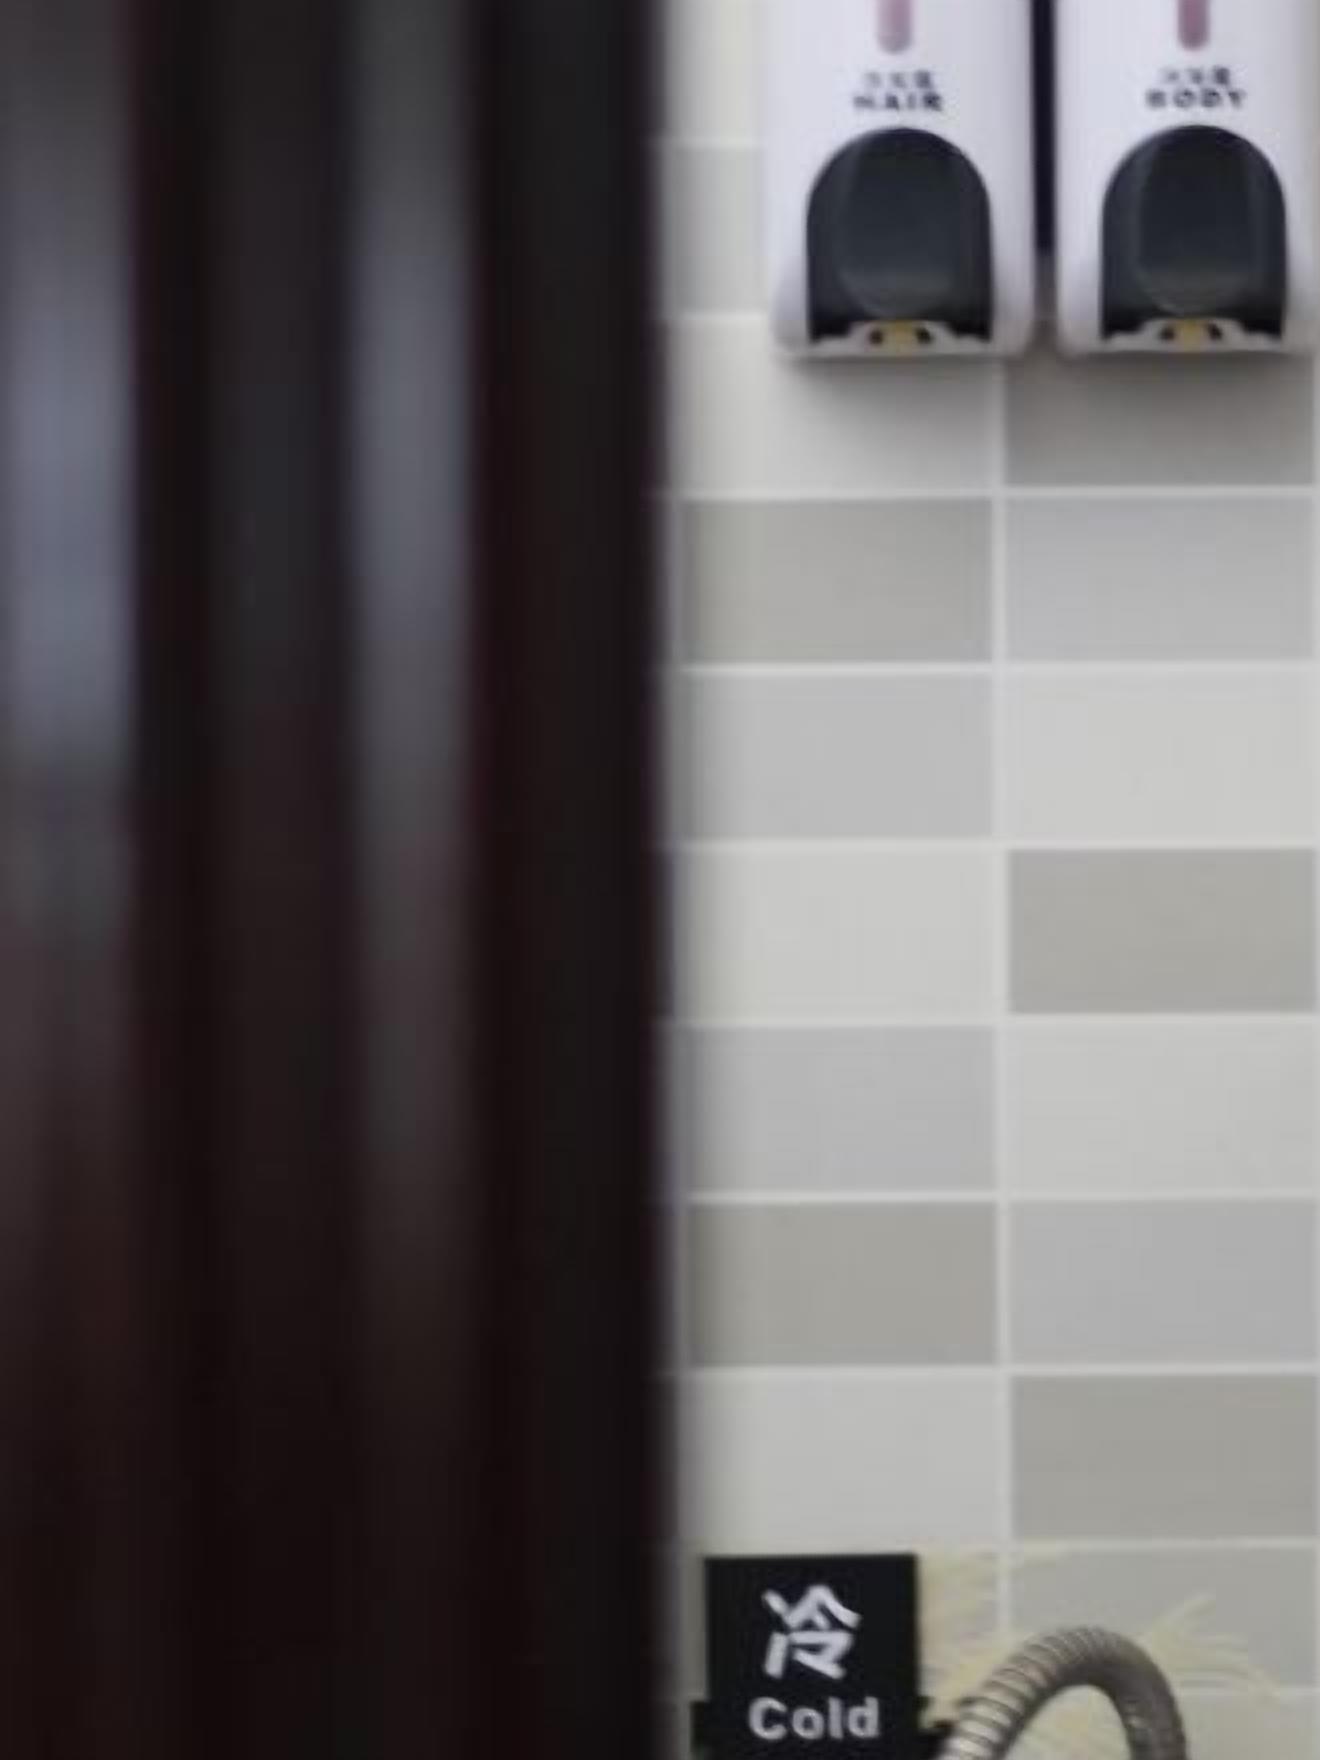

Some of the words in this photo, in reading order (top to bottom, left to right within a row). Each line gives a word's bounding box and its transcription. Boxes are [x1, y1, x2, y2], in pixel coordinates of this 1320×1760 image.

[1144, 88, 1246, 109] BODY
[762, 1584, 861, 1680] 冷
[748, 1696, 880, 1741] Cold
